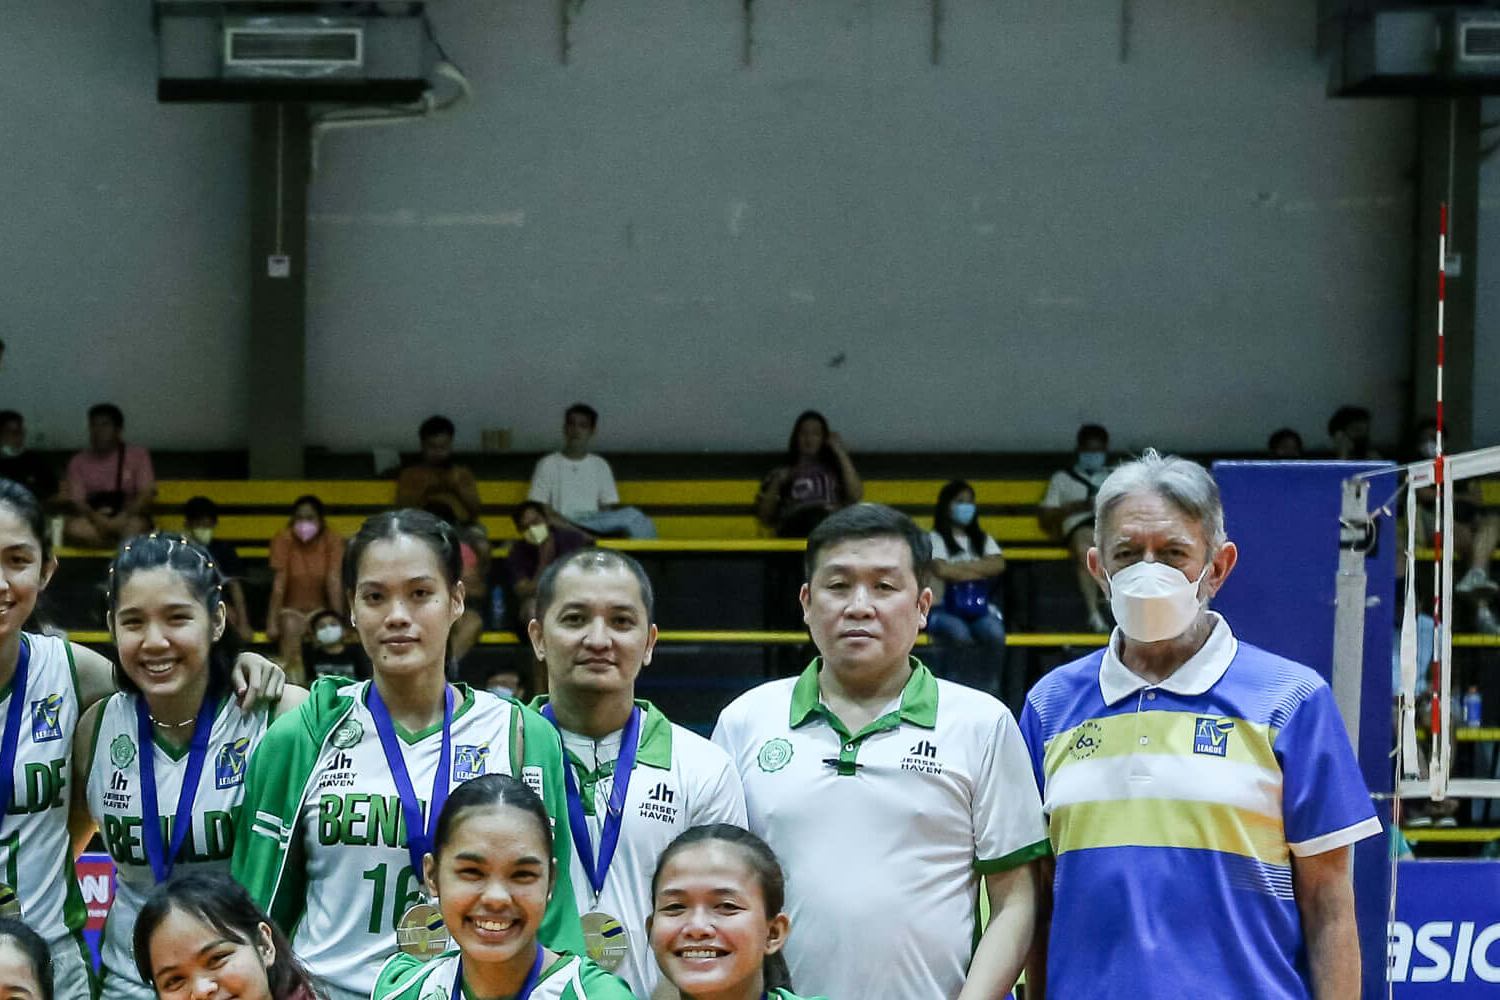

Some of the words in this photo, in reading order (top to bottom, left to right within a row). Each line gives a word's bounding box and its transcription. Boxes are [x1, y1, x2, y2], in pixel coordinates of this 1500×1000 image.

[1197, 743, 1223, 754] LEAGUE
[900, 757, 944, 768] JERSEY
[901, 763, 942, 775] HAVEN
[320, 771, 357, 781] JERSEY
[318, 779, 354, 788] HAVEN
[639, 802, 678, 816] JERSEY
[640, 810, 675, 824] HAVEN
